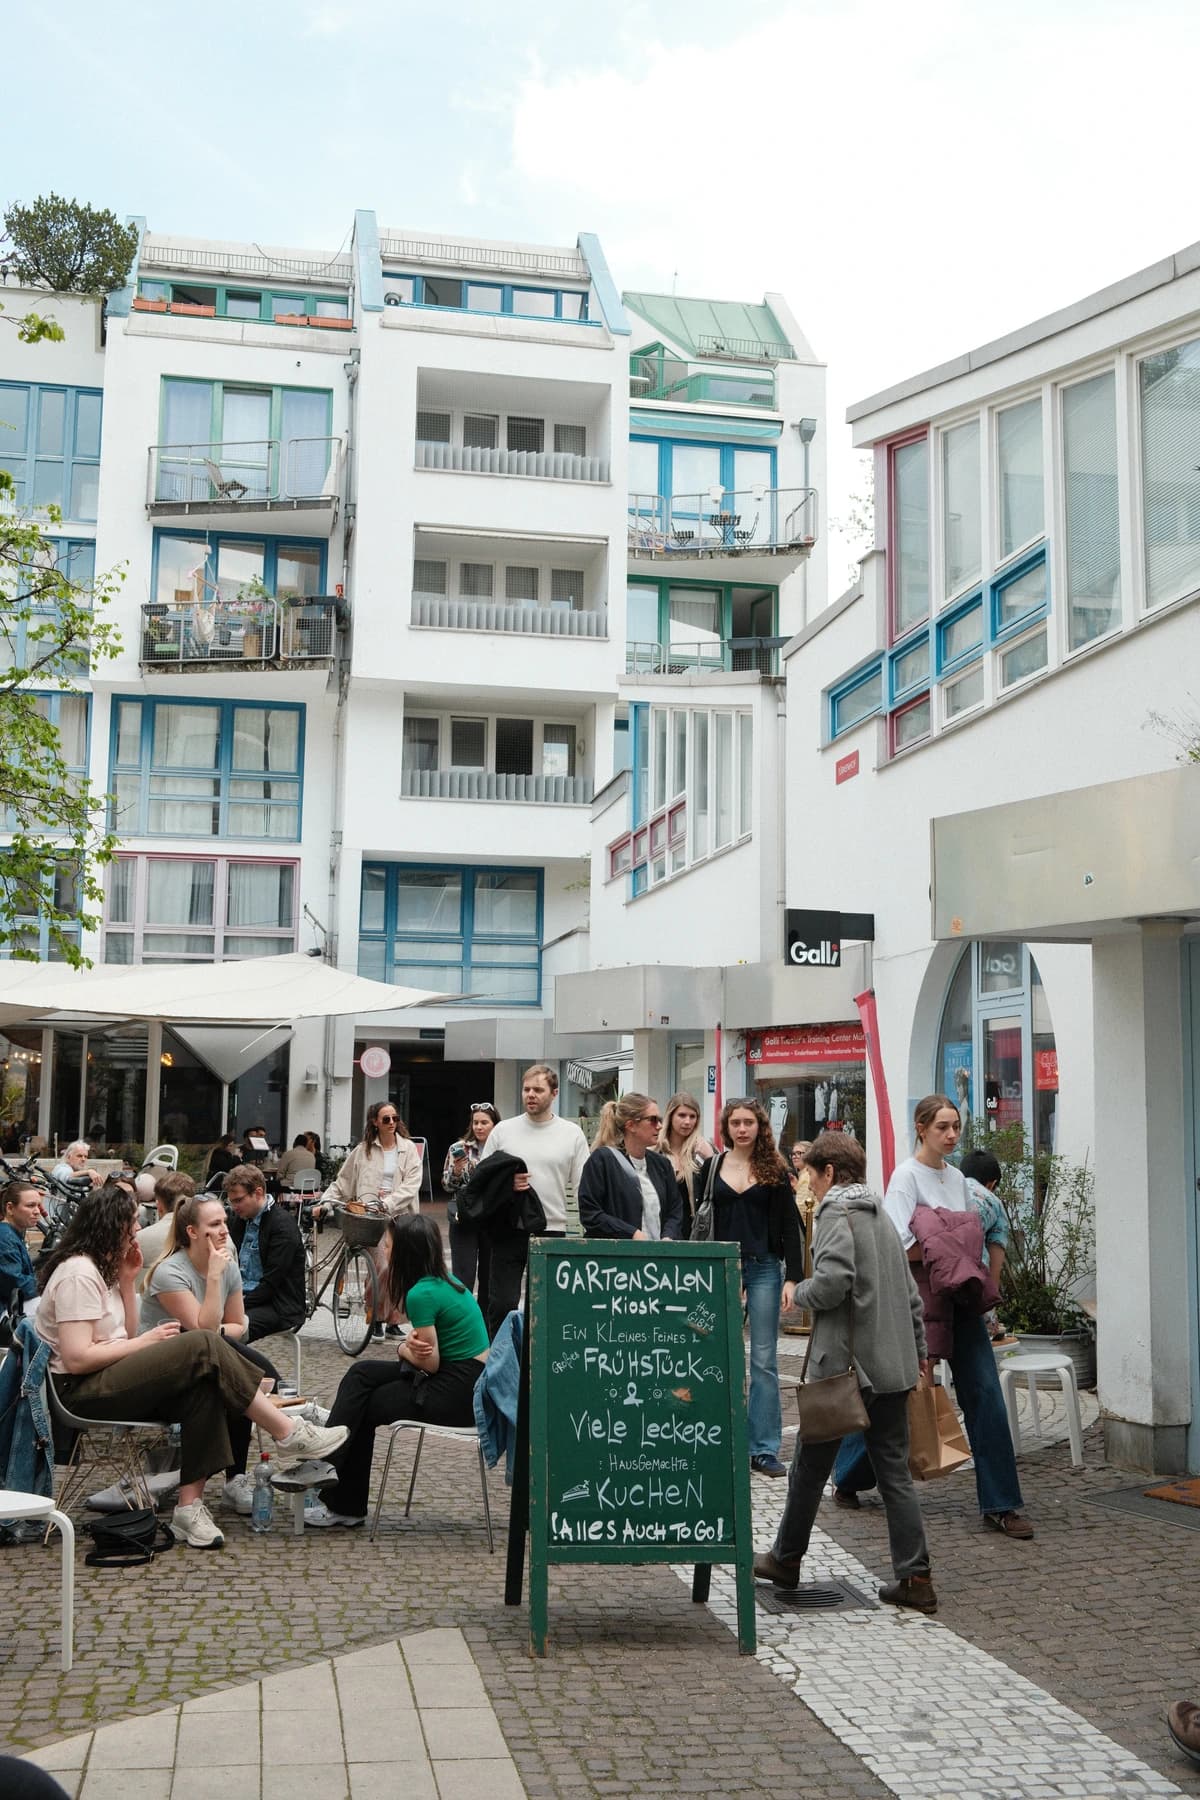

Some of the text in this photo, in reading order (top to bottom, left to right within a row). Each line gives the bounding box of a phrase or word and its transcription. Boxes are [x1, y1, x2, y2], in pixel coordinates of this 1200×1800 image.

[790, 940, 839, 965] Galli
[831, 1032, 851, 1043] Center
[583, 1347, 705, 1382] FRÜHSTÜCK
[622, 1518, 667, 1545] AUCH
[669, 1520, 691, 1543] To
